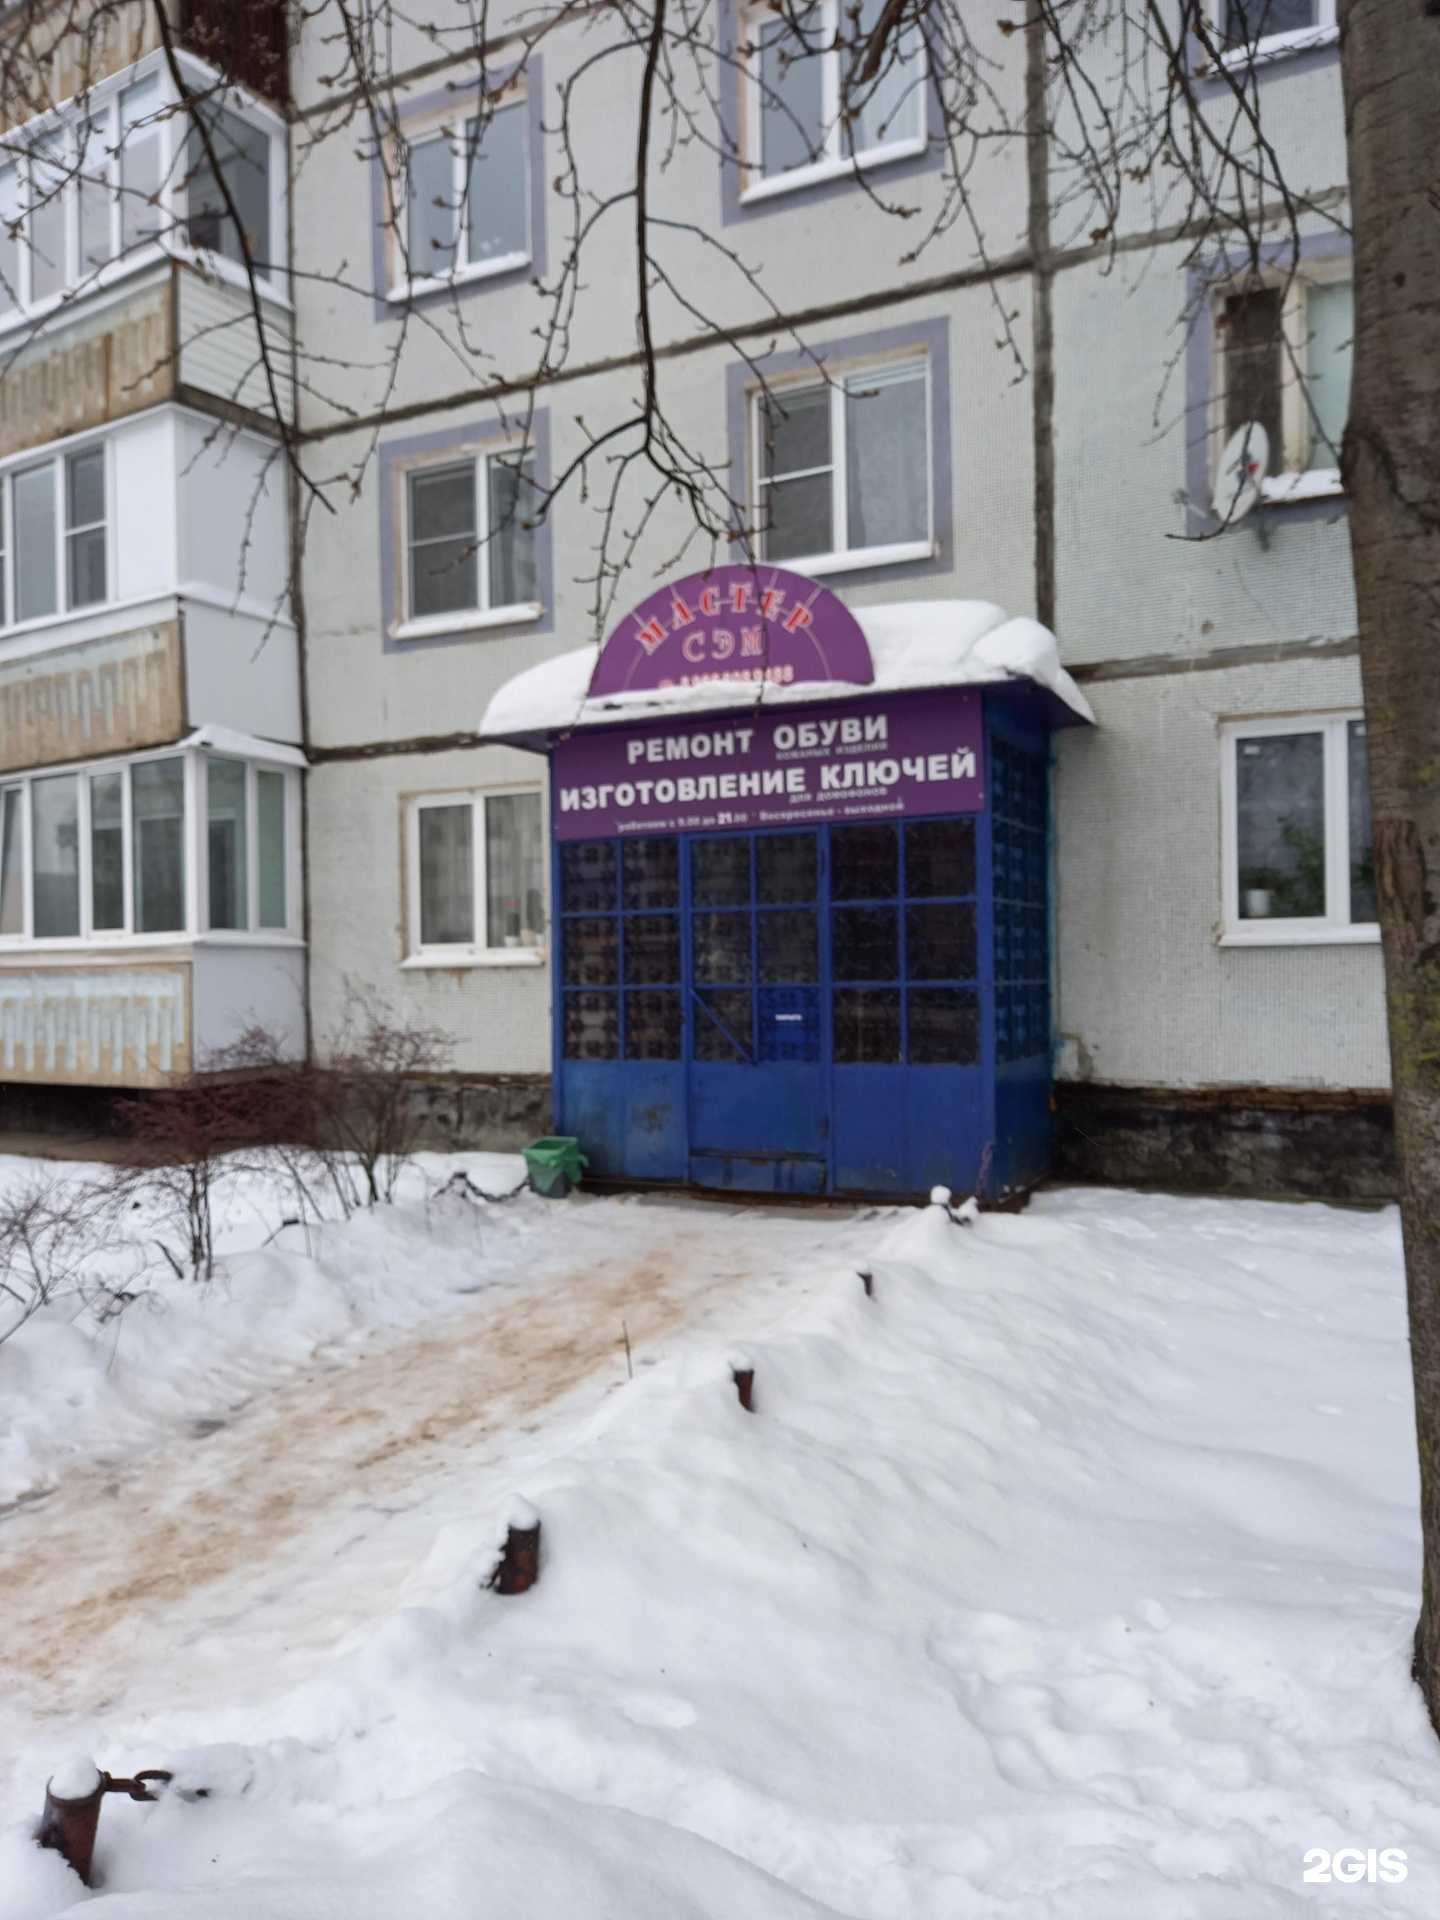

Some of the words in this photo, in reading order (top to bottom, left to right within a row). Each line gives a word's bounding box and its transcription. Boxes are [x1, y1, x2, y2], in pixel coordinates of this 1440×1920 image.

[635, 581, 814, 656] МАСТЕР
[682, 626, 764, 663] СЭМ
[627, 729, 754, 764] РЕМОНТ
[773, 714, 888, 751] ОБУВИ
[560, 768, 806, 811] ИЗГОТОВЛЕНИЕ
[821, 747, 977, 790] КЛЮЧЕЙ
